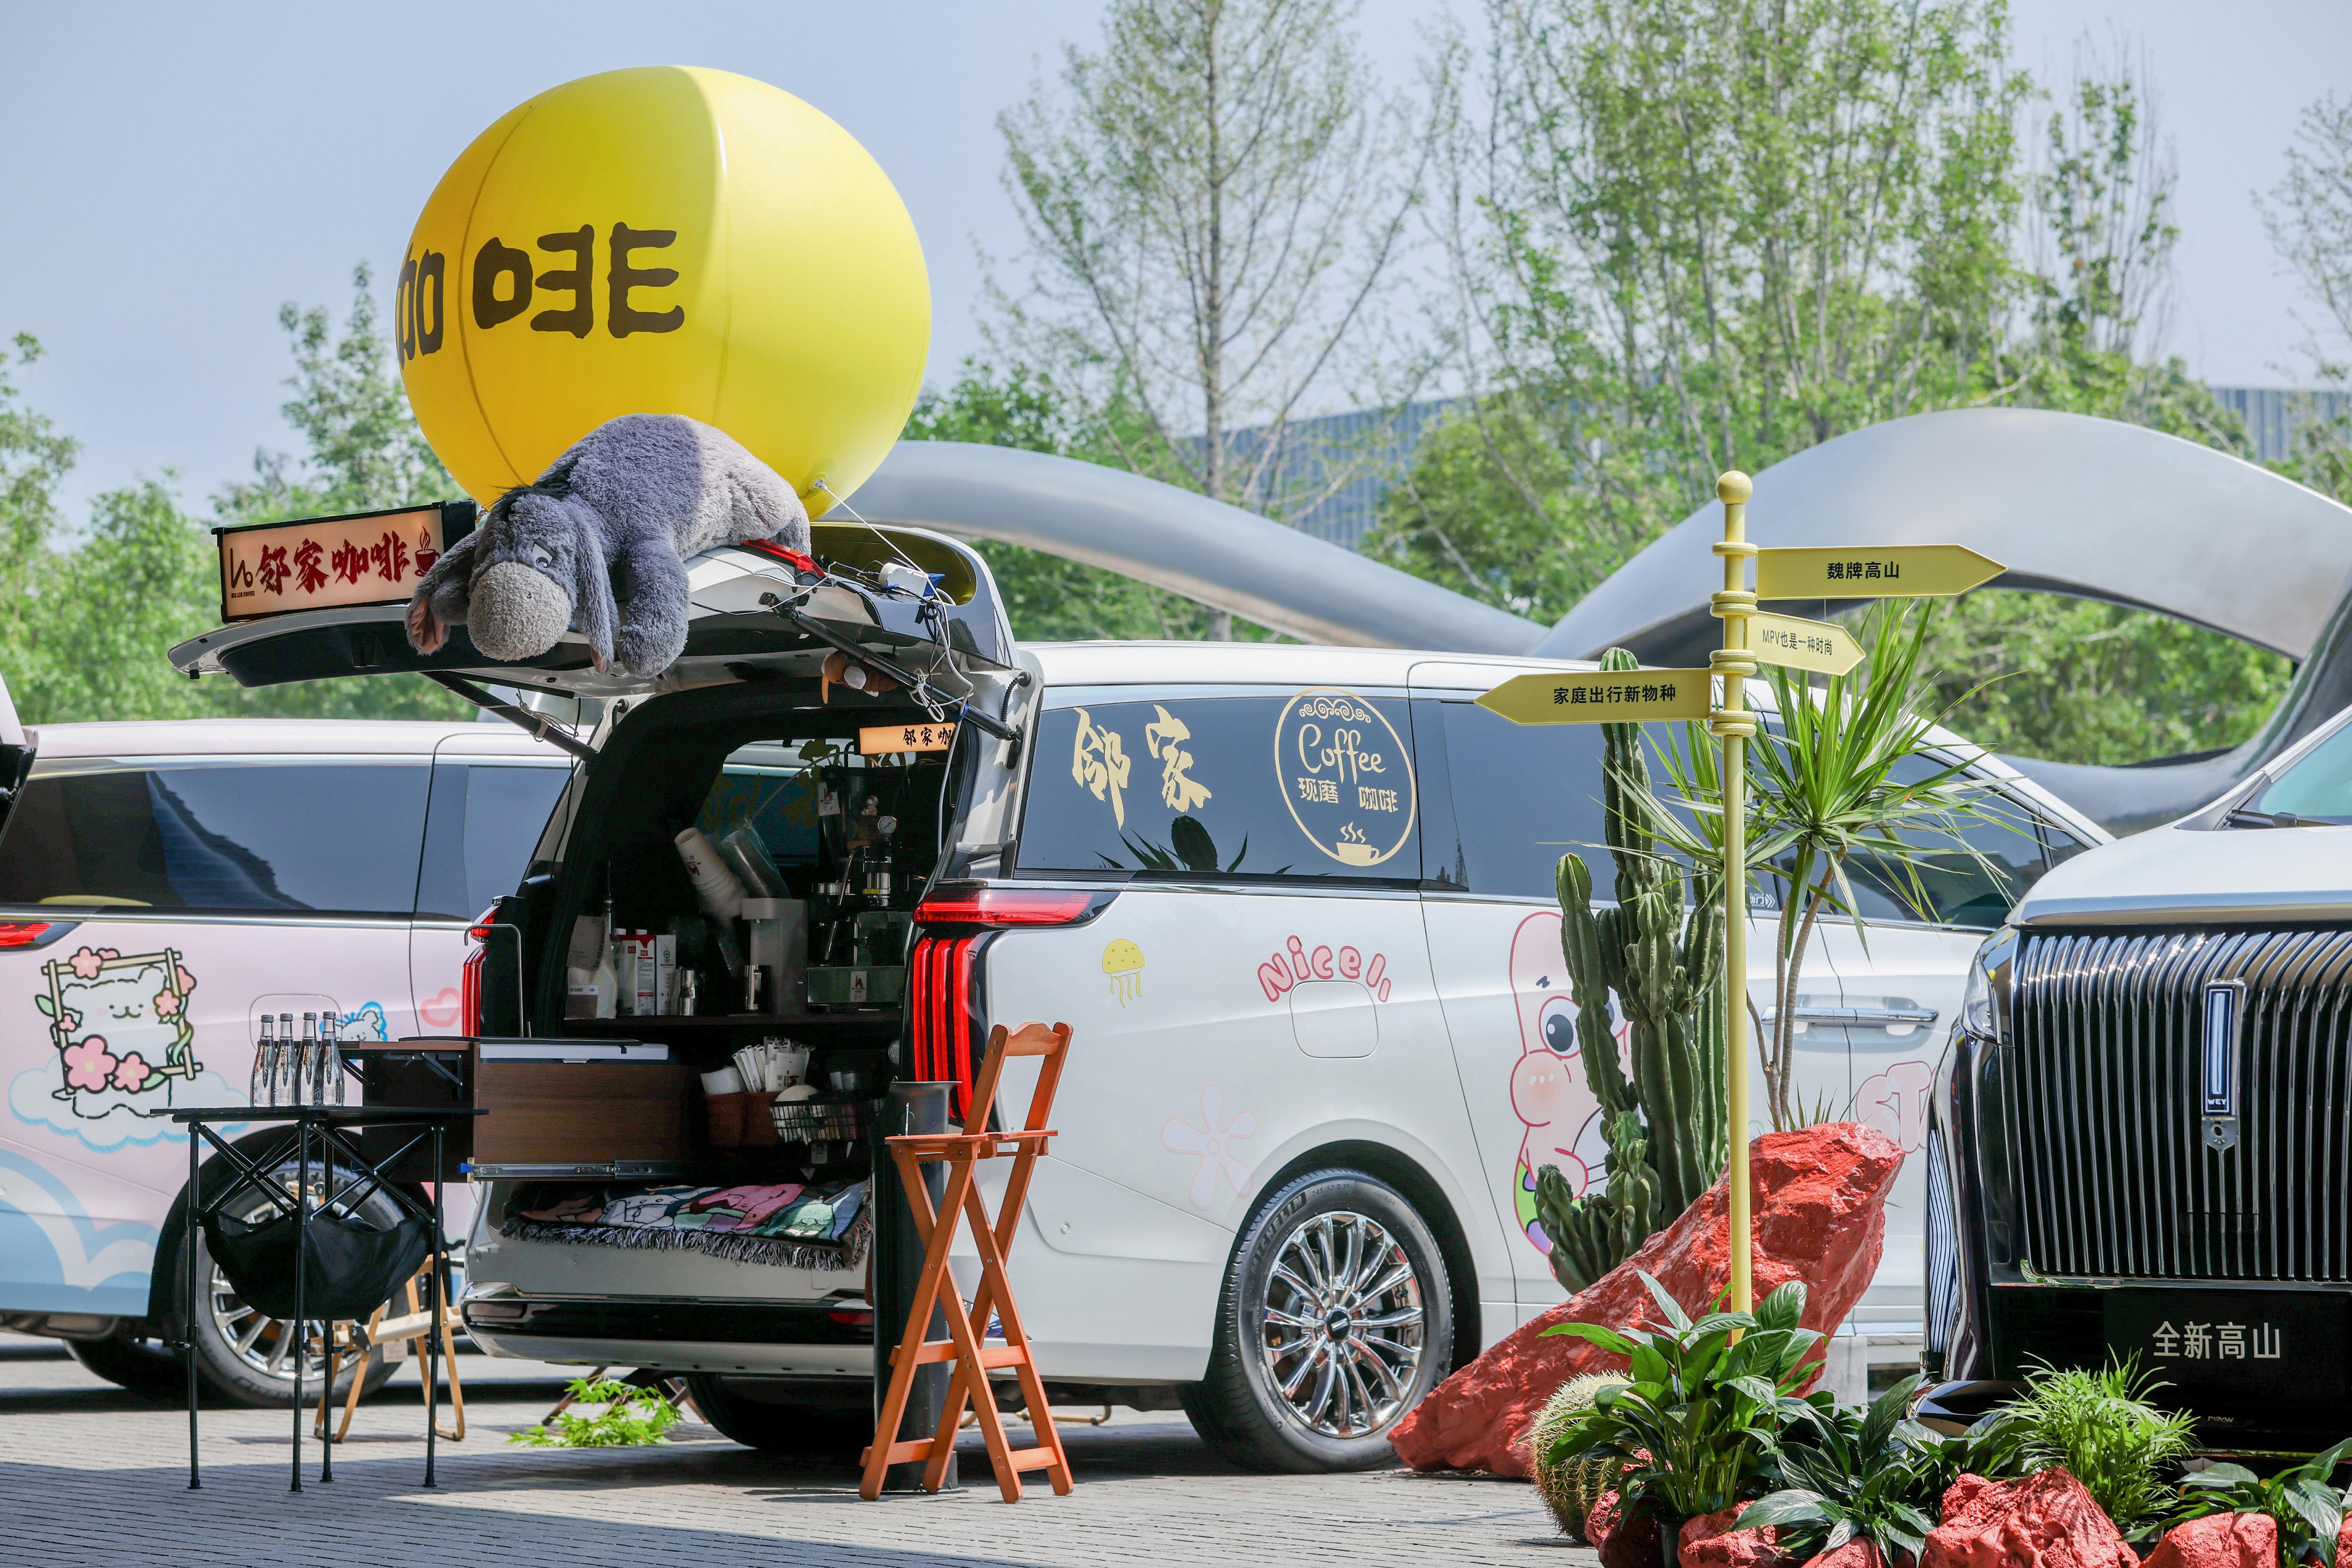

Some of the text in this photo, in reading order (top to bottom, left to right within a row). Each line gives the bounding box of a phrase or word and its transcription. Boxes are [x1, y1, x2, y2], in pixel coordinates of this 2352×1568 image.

[256, 530, 411, 596] 邻家咖啡
[1827, 561, 1900, 580] 魏牌高山
[1763, 629, 1832, 655] MPV也是一种时尚
[1553, 683, 1677, 705] 家庭出行新物种
[1299, 724, 1386, 784] Coffee
[1298, 777, 1399, 813] 现磨 咖啡
[2152, 1321, 2280, 1359] 全新高山
